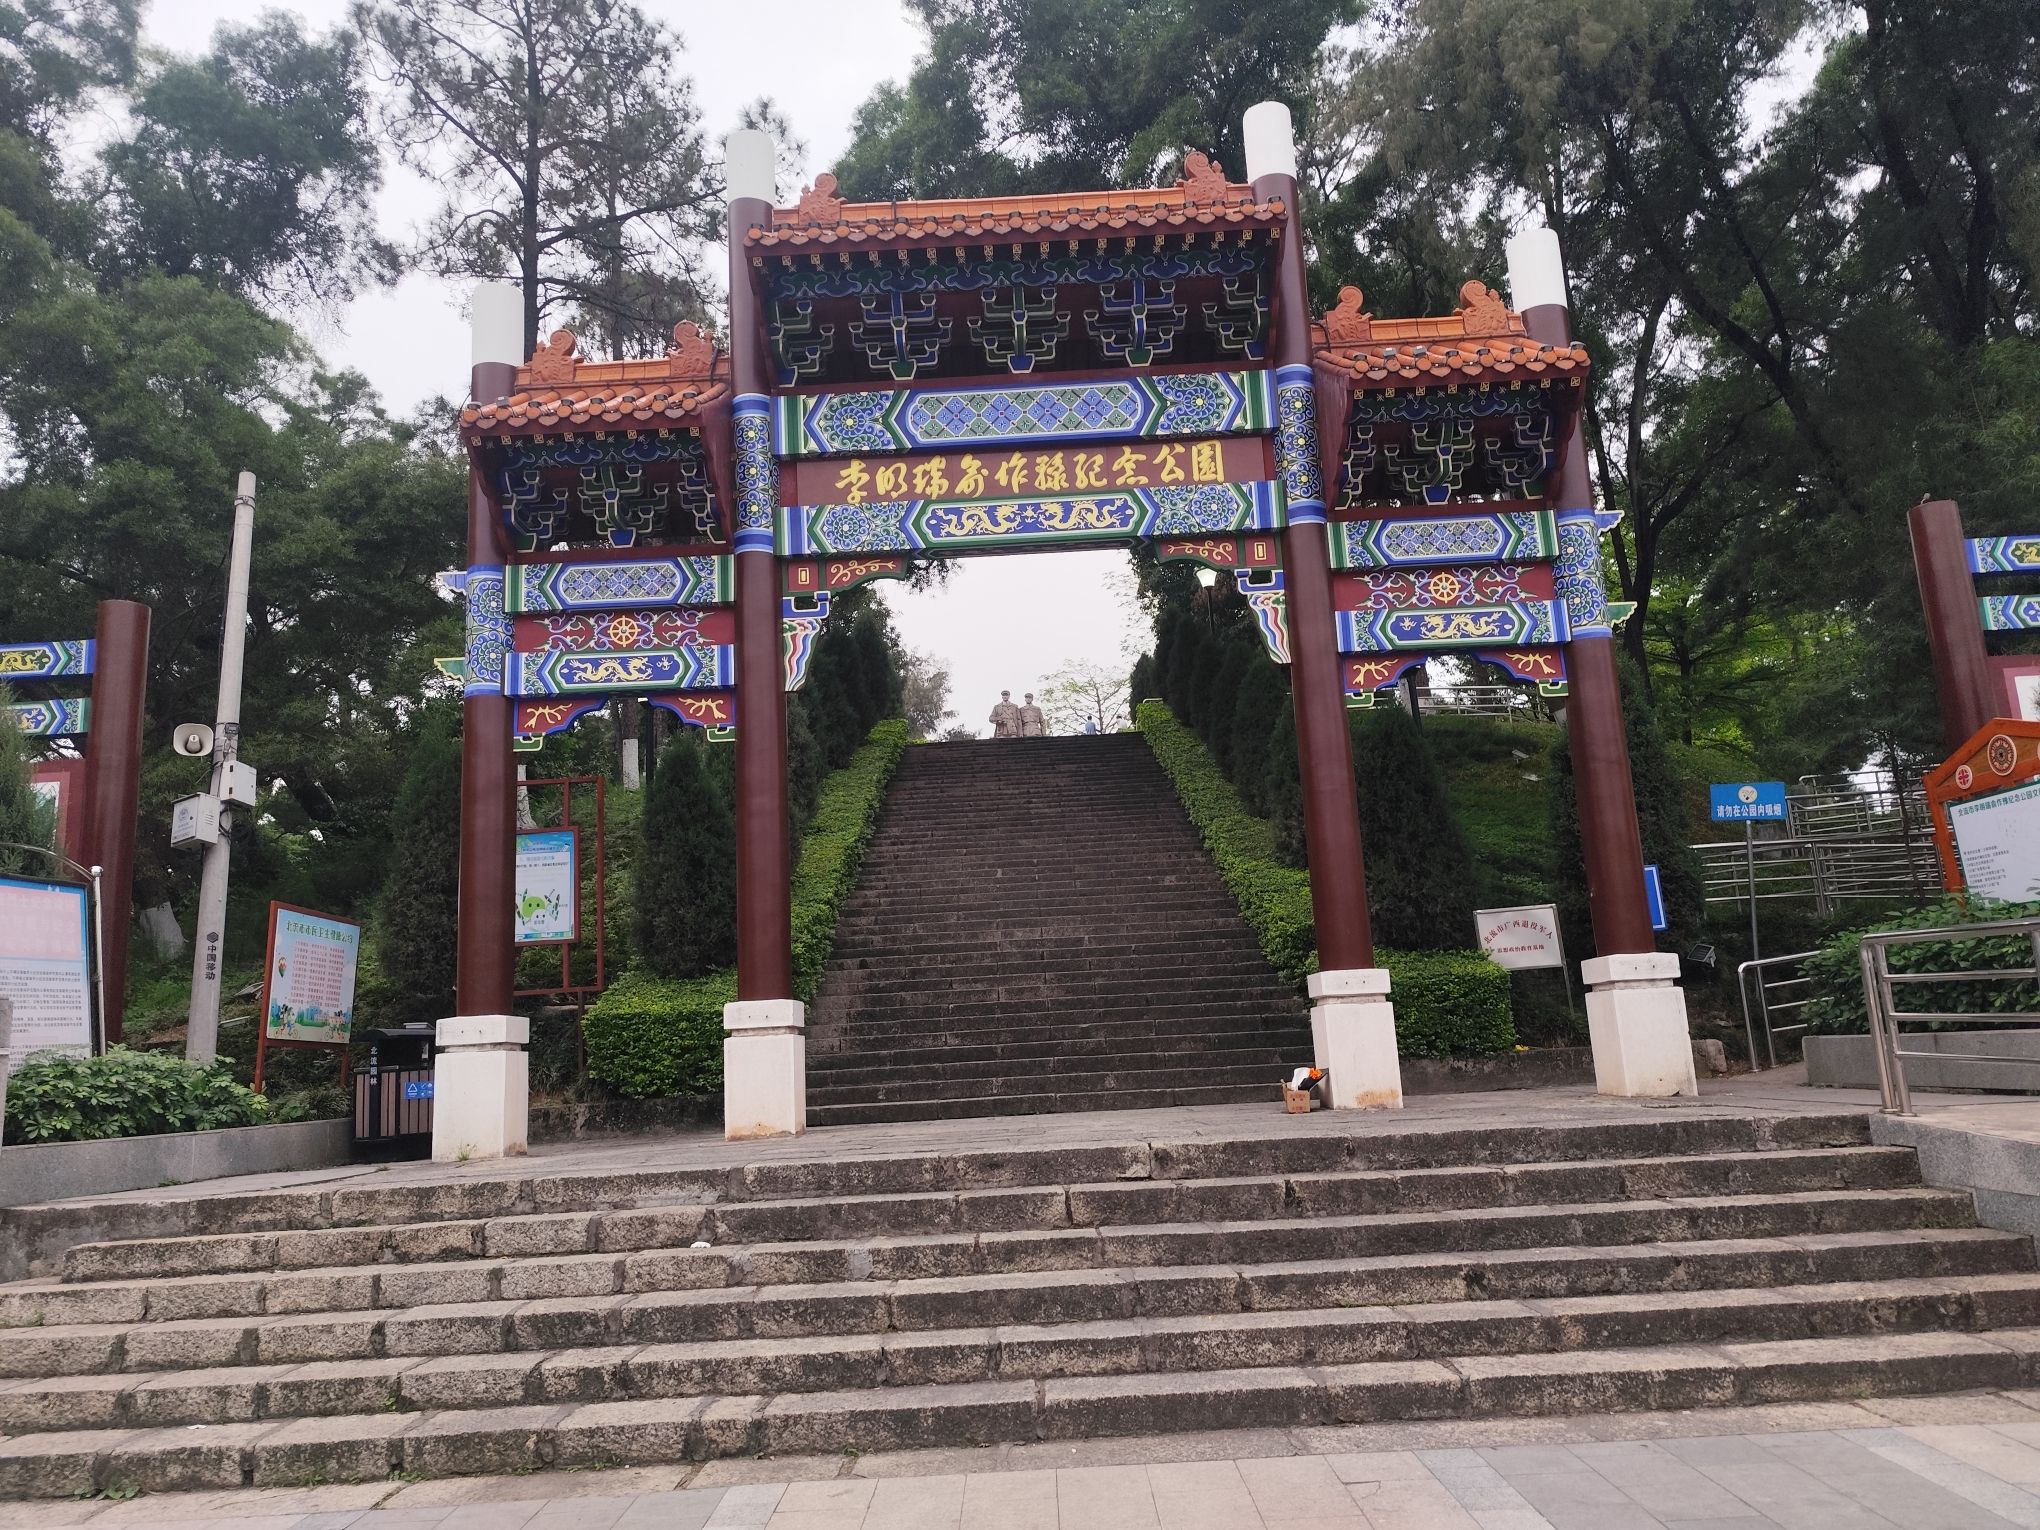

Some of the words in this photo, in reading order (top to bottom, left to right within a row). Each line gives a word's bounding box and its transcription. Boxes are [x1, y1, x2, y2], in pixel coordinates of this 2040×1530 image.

[1717, 803, 1782, 818] 请勿在公园内吸烟
[1484, 919, 1553, 944] 北流市广西退役军人
[205, 944, 217, 981] 中国移动
[370, 1046, 378, 1086] 北流园林
